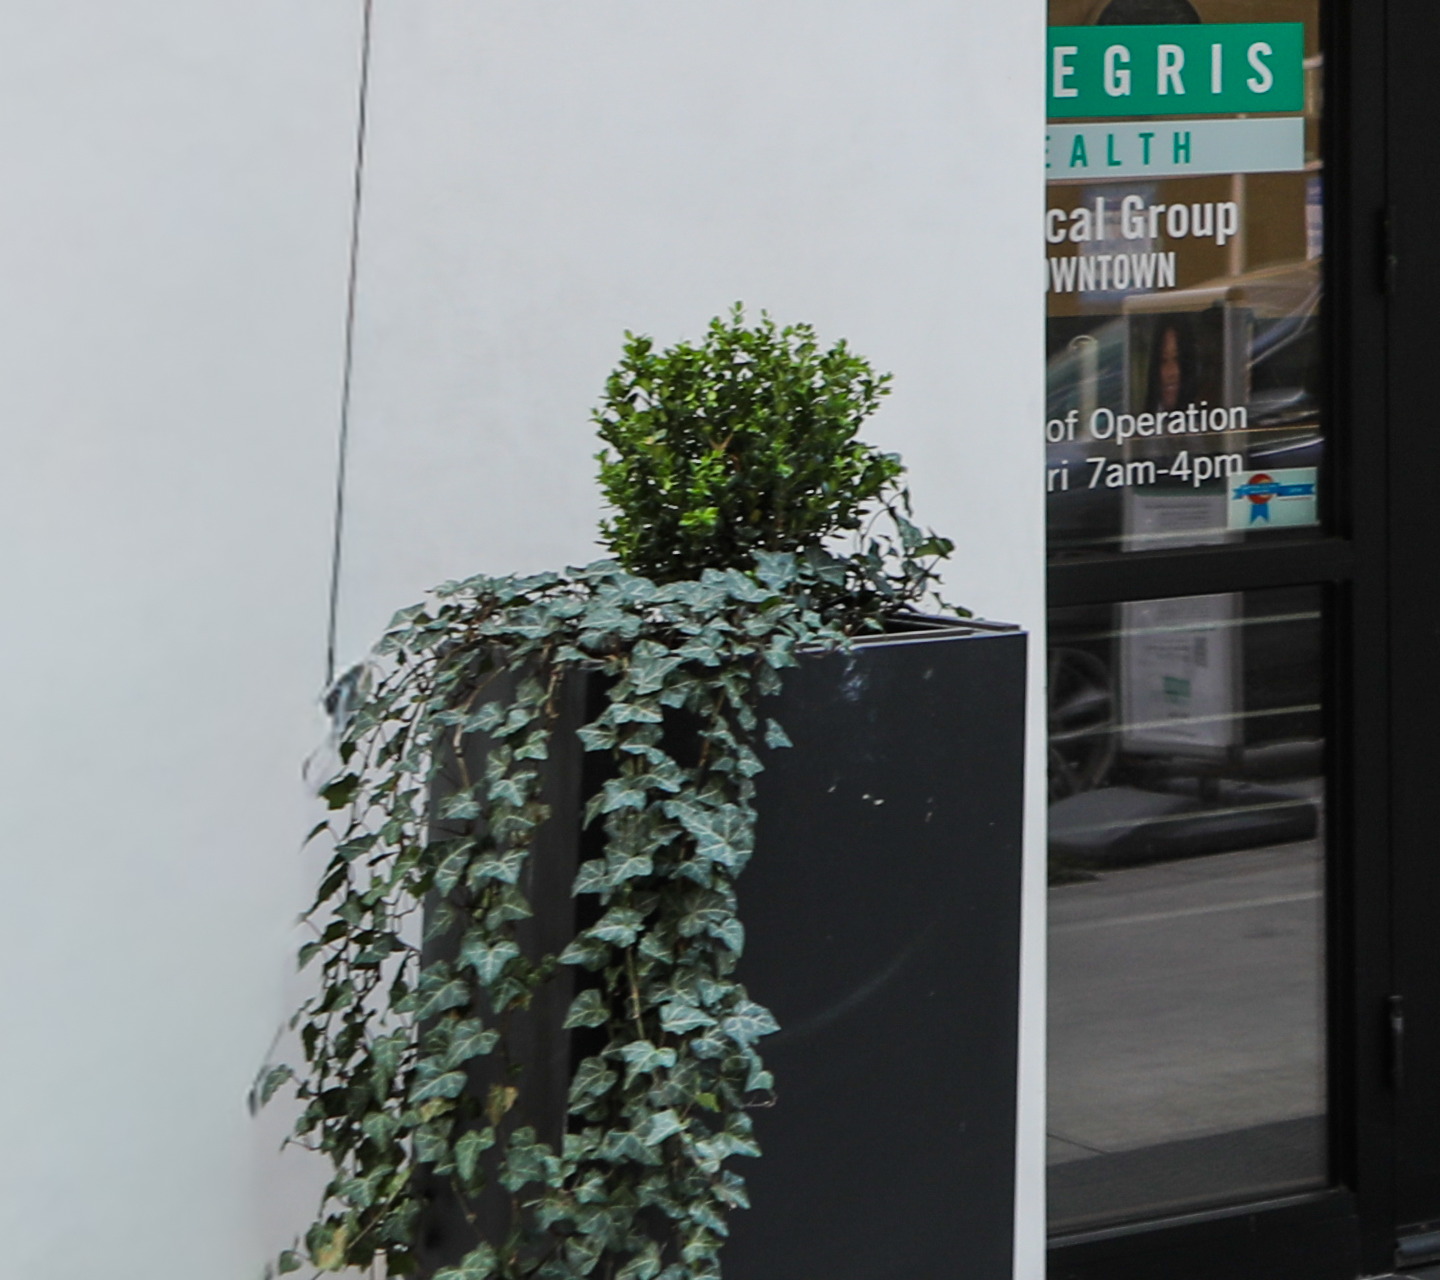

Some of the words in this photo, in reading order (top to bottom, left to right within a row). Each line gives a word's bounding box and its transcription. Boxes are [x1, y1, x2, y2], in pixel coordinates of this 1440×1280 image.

[1046, 131, 1191, 169] ALTH
[1121, 195, 1239, 246] Group
[1046, 252, 1176, 292] WNTOWN
[1047, 410, 1079, 442] of
[1090, 401, 1248, 446] Operation
[1086, 451, 1244, 489] 7am-4pm
